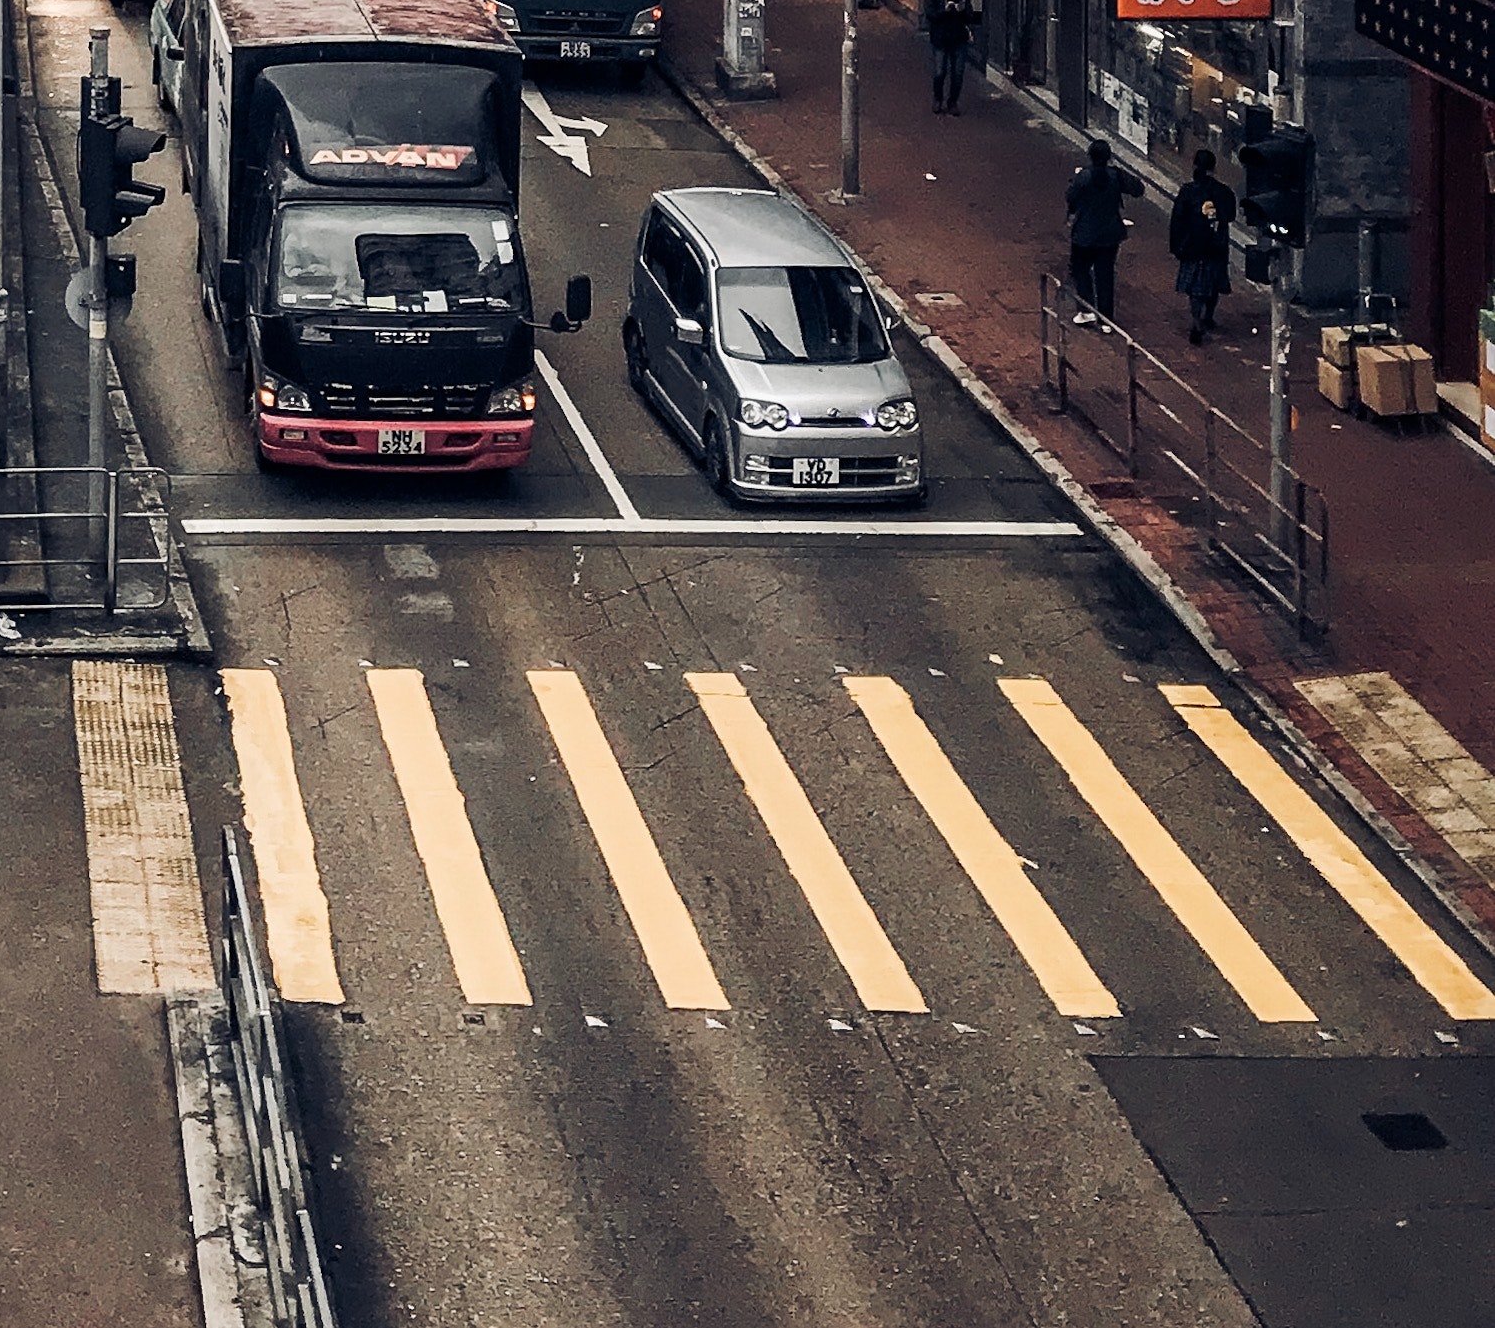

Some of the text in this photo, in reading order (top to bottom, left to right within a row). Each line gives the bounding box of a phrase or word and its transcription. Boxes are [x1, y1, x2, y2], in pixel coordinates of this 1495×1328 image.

[309, 146, 462, 170] ADVAN
[391, 429, 413, 444] NH
[381, 441, 422, 454] 5234
[799, 470, 834, 484] 1307
